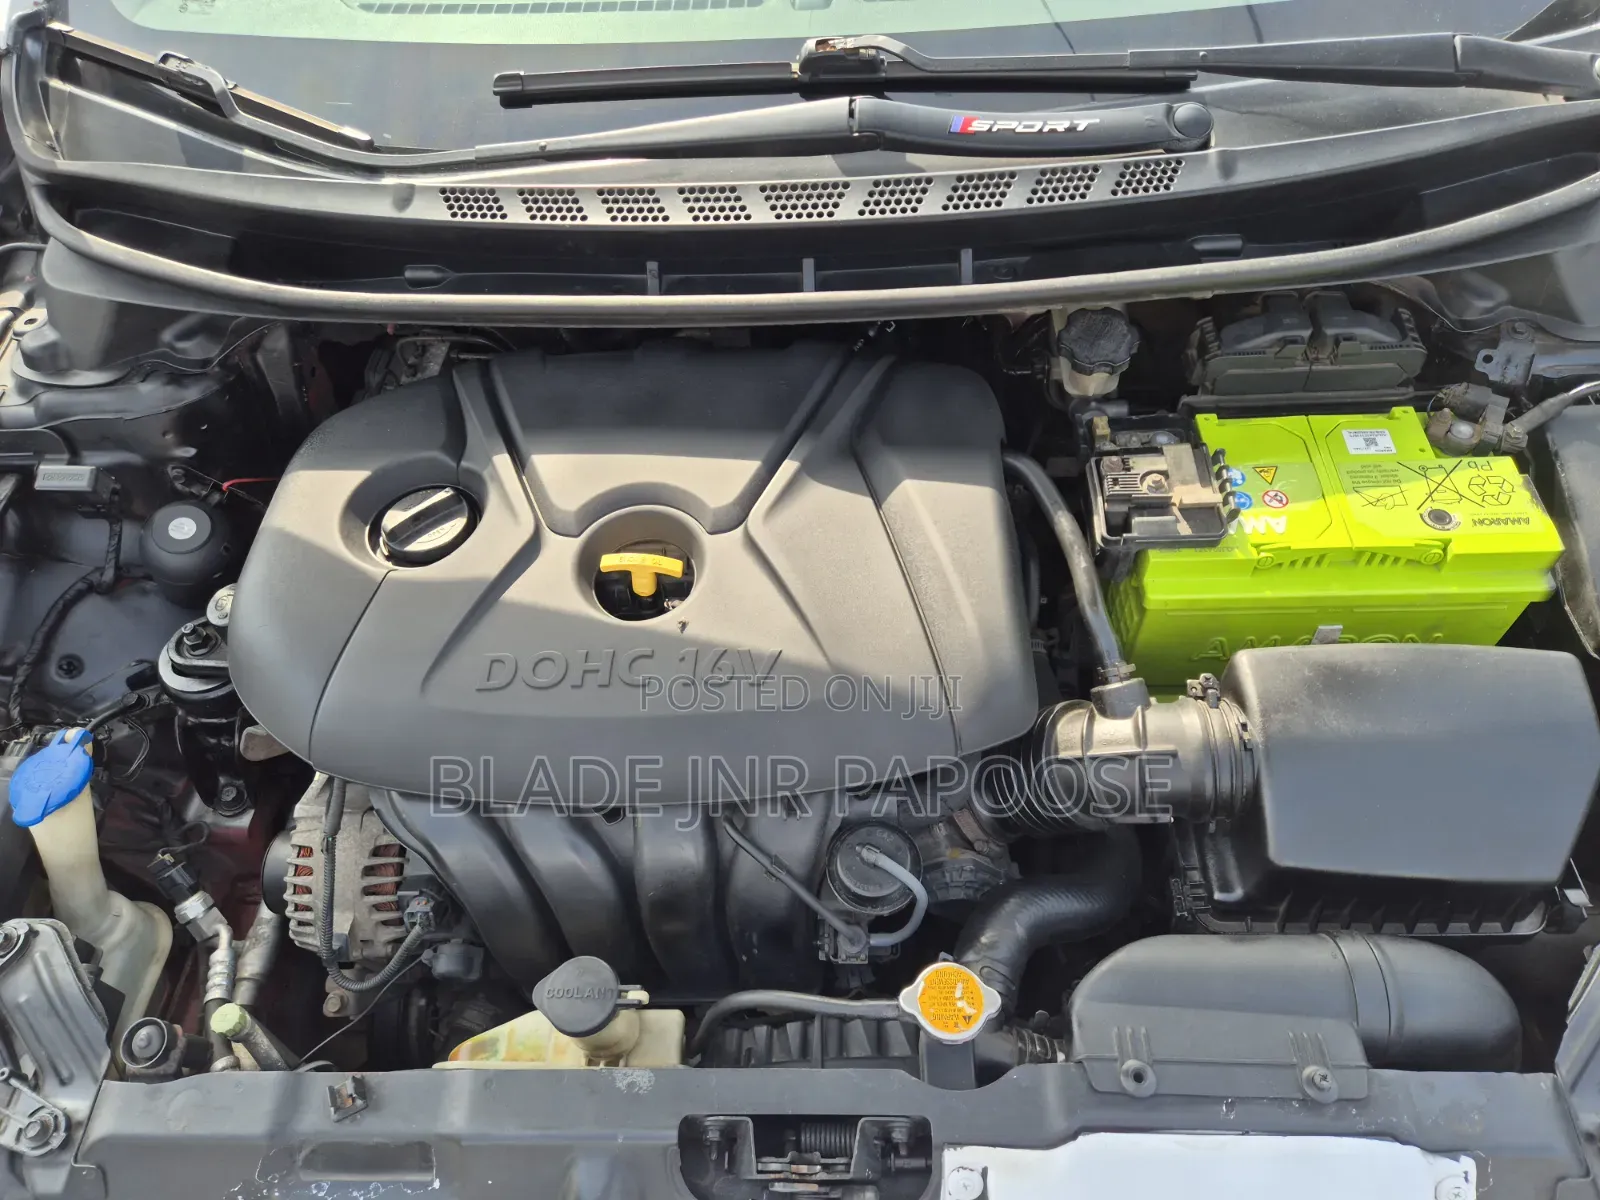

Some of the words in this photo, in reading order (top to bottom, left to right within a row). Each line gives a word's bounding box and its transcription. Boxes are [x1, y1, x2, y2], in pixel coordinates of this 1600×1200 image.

[967, 118, 1100, 133] SPORT
[1467, 460, 1495, 473] Pb
[1471, 517, 1530, 527] AMARON
[476, 648, 655, 692] DOHC
[678, 648, 783, 687] 16V
[545, 986, 614, 1000] COOLANT
